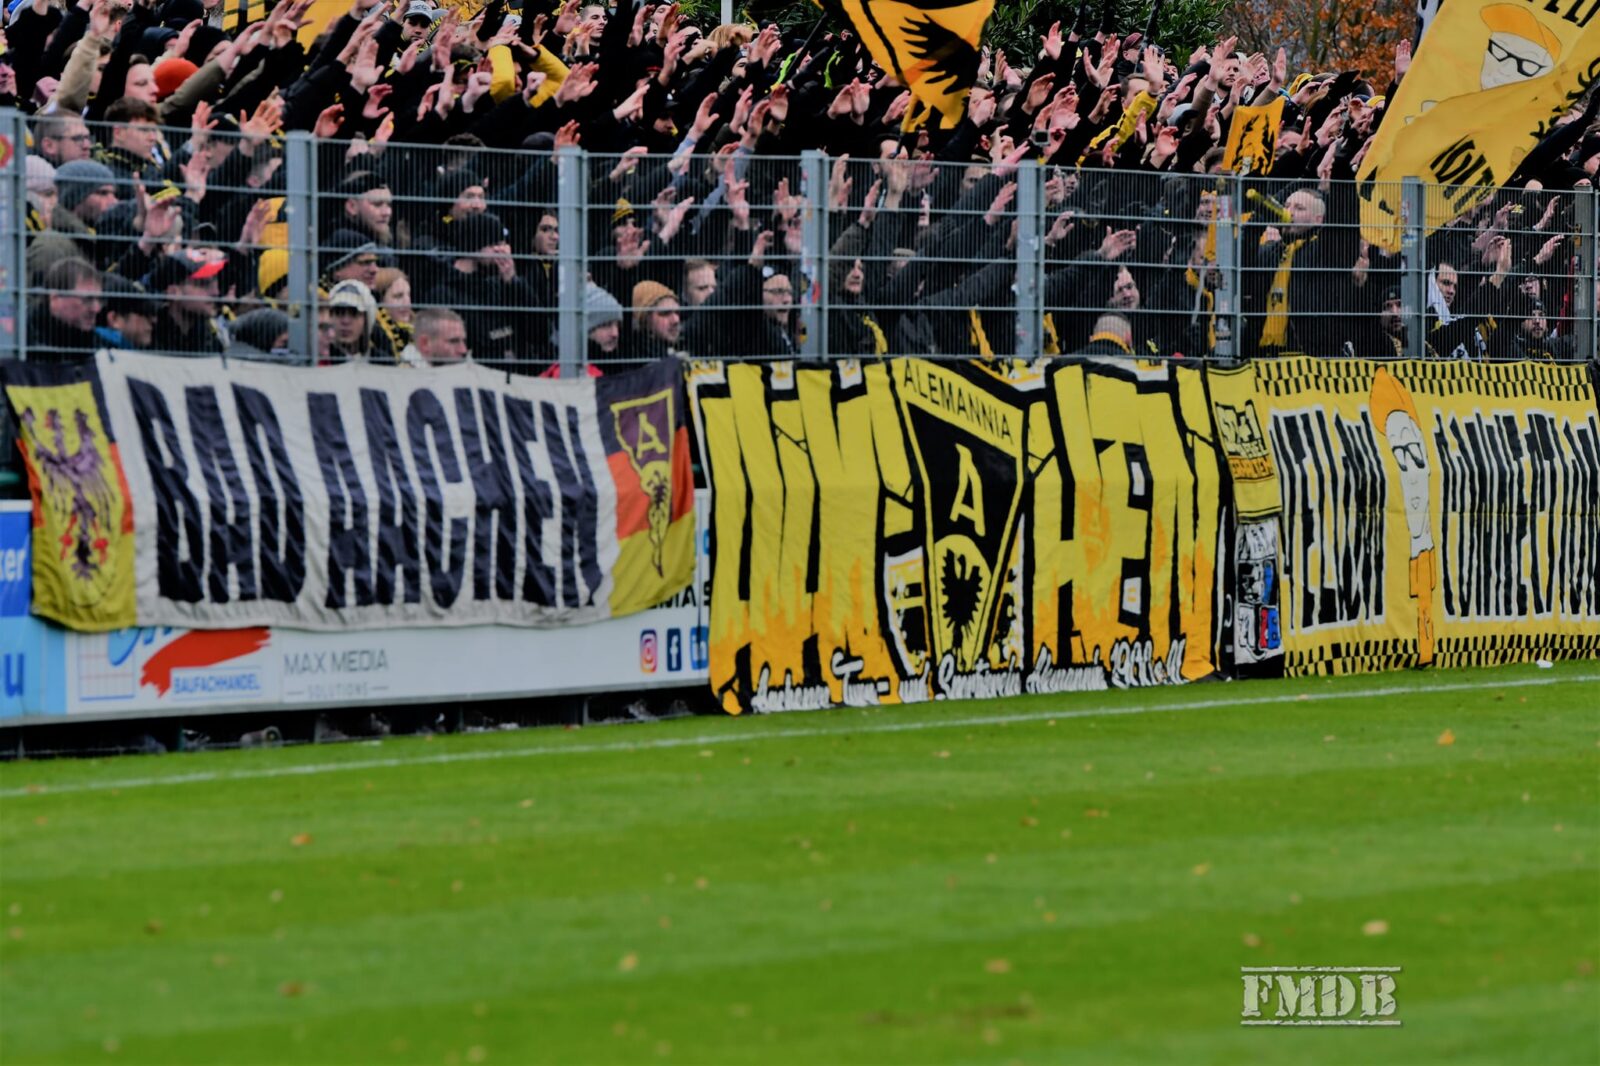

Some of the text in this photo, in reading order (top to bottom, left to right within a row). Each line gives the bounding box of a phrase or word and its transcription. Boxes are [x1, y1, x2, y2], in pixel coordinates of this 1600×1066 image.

[636, 412, 667, 459] A
[904, 359, 1014, 446] ALEMANNIA
[126, 375, 604, 609] BAD AACHEN
[950, 443, 985, 537] A
[284, 648, 389, 676] MAX MEDIA
